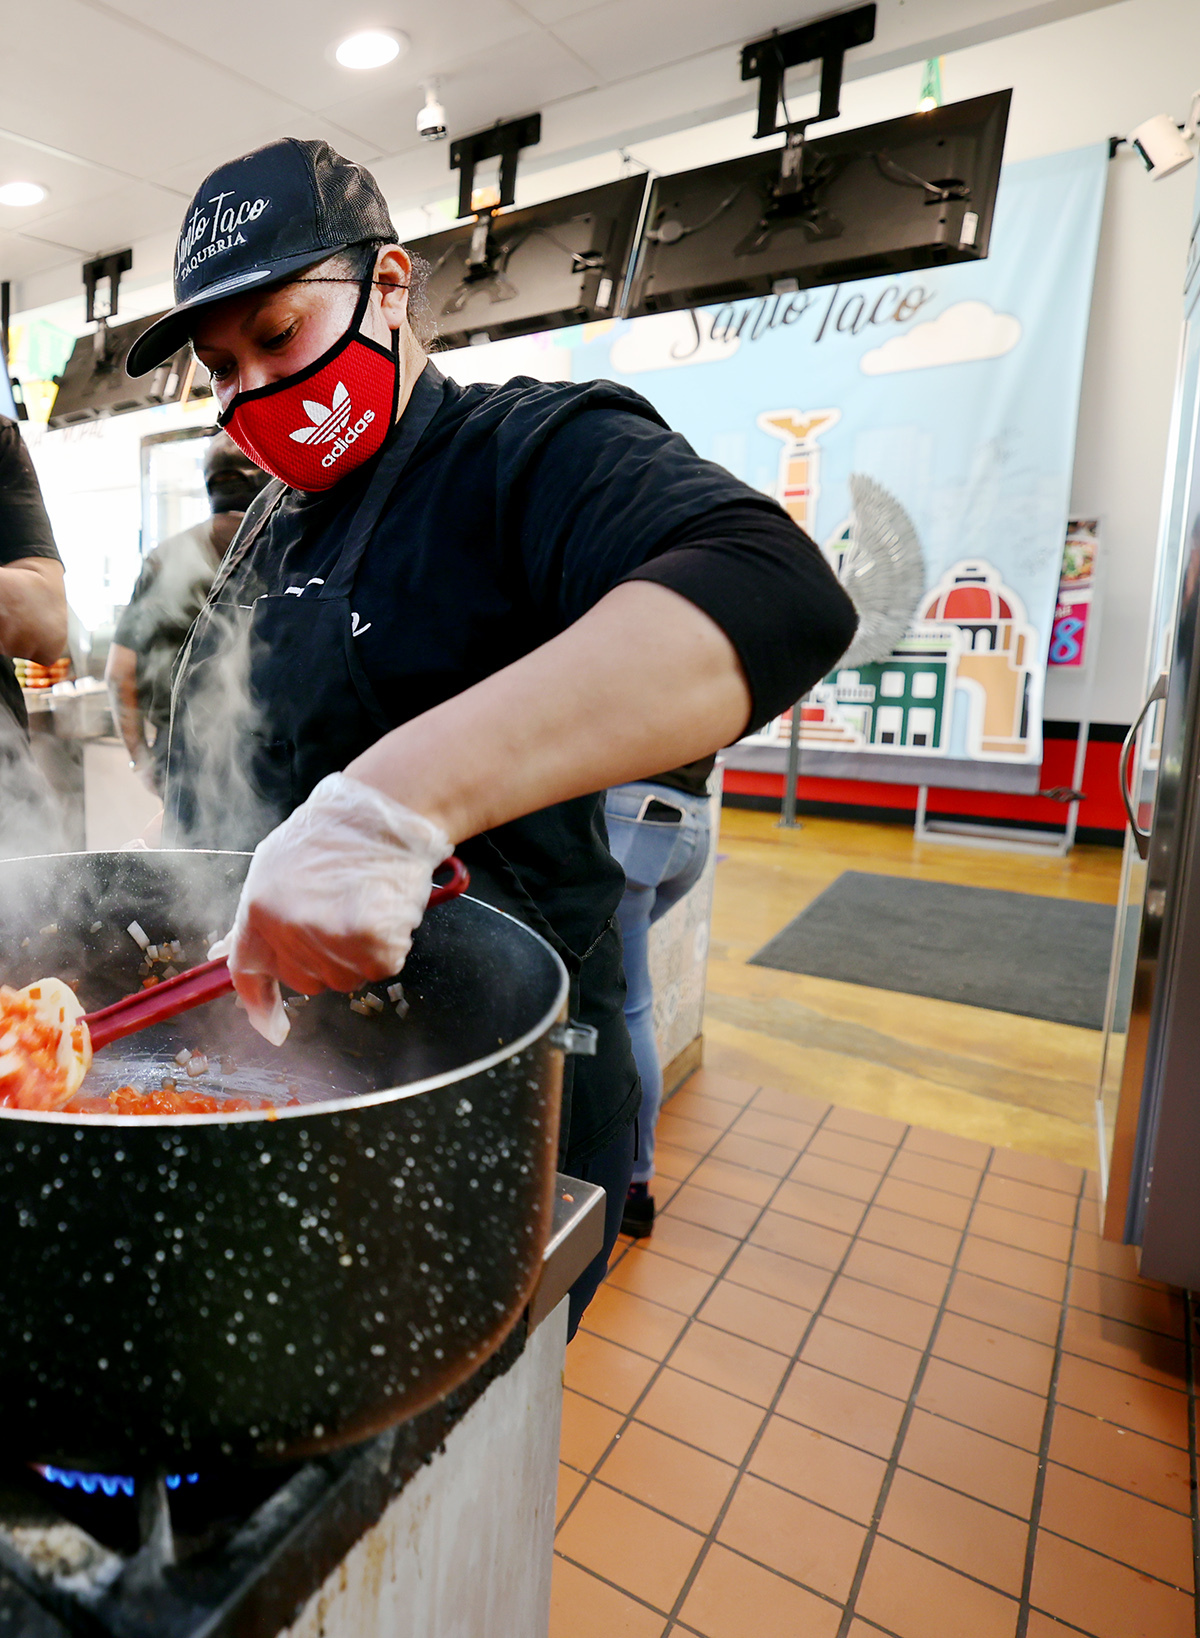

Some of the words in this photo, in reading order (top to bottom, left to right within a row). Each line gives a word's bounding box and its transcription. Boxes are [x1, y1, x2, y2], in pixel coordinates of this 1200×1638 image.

[208, 190, 270, 243] Taco
[181, 231, 247, 281] TAQUERIA
[321, 409, 376, 468] adidas
